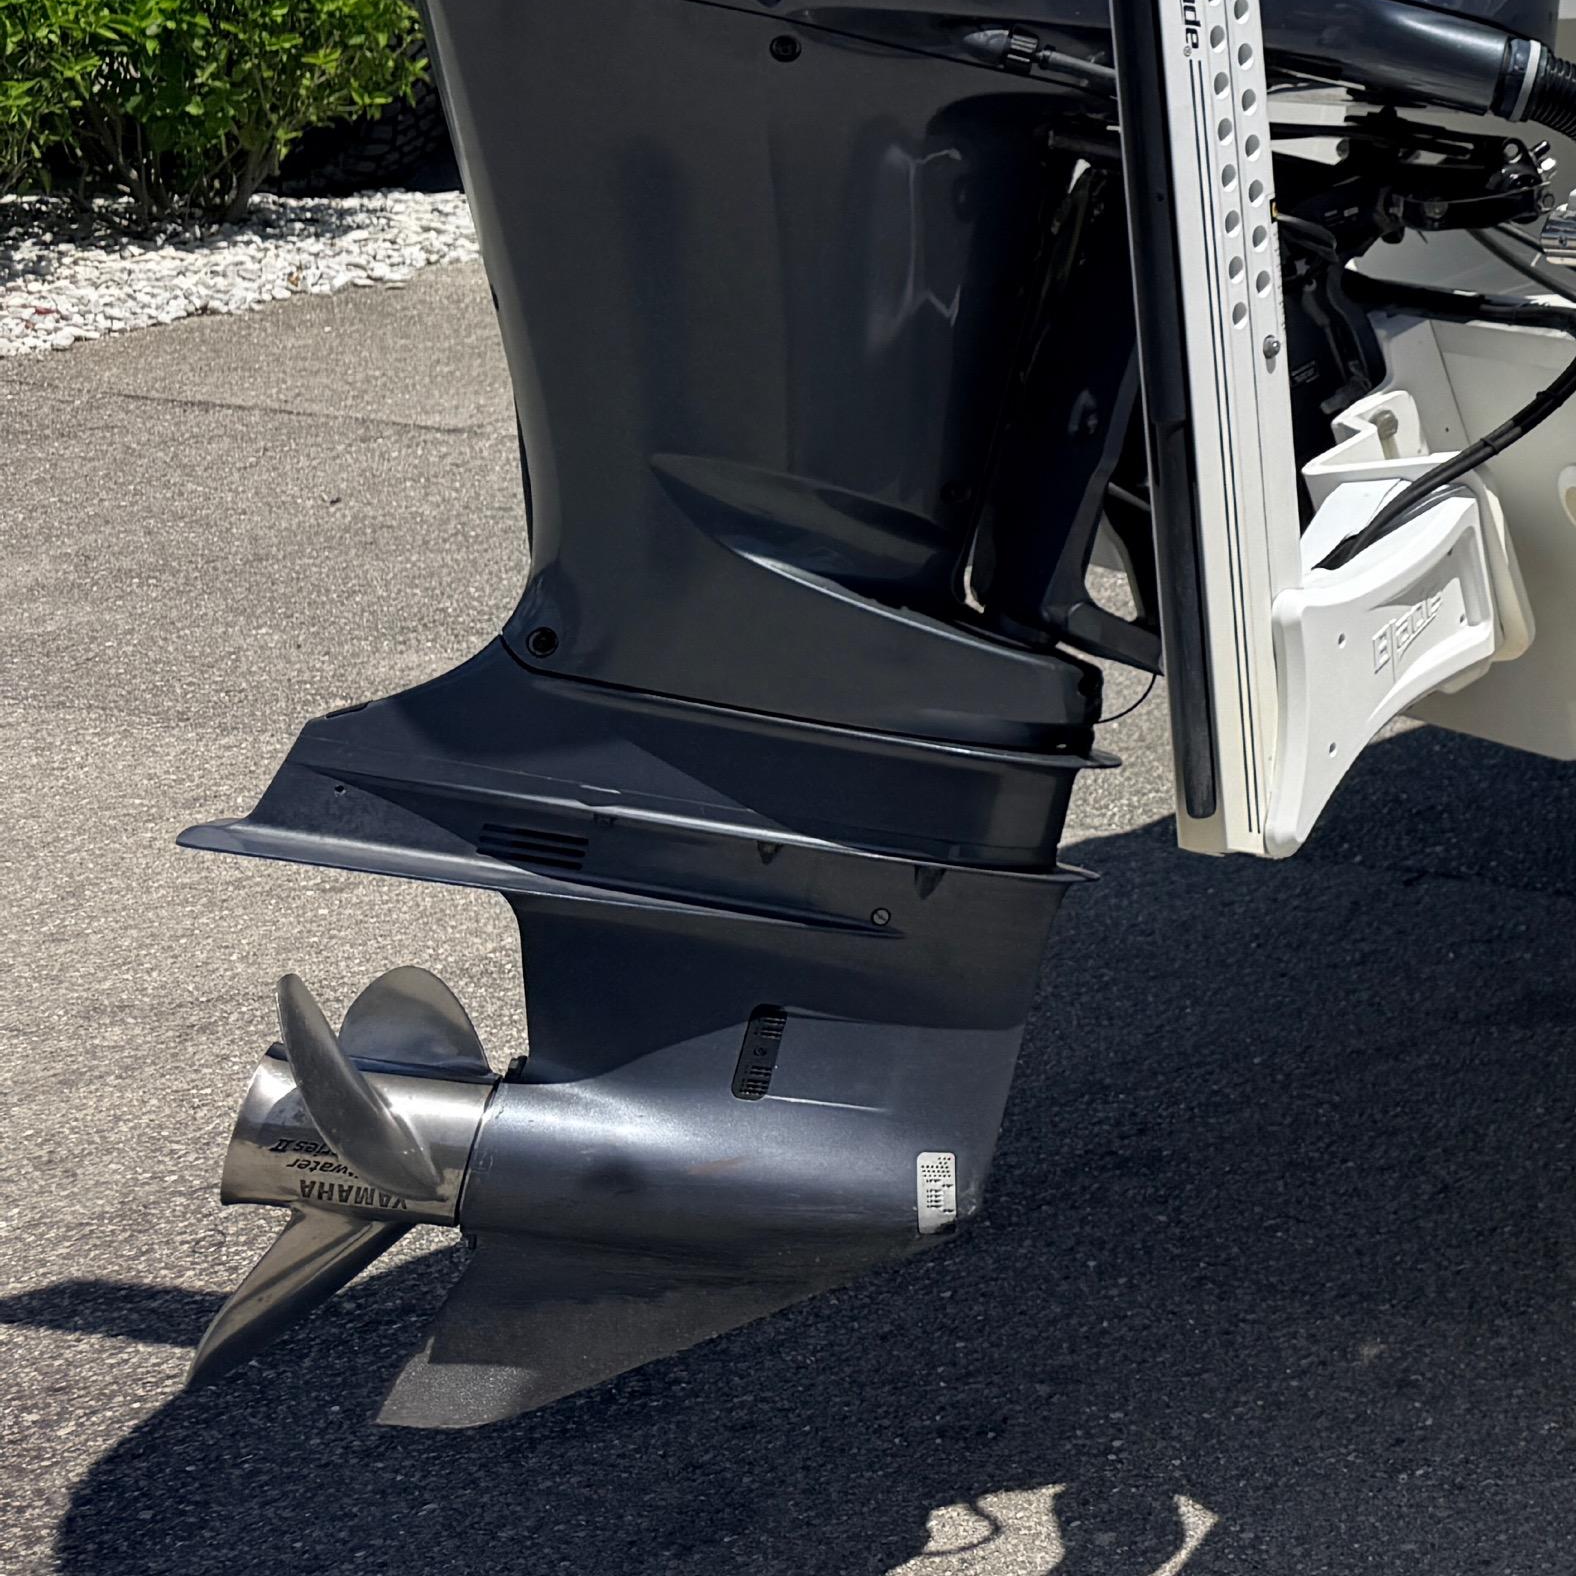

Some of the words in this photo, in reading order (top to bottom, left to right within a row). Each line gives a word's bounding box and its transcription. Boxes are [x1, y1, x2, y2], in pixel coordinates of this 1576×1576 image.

[293, 1139, 341, 1159] ries
[286, 1157, 360, 1180] water
[299, 1178, 408, 1210] YAMAHA
